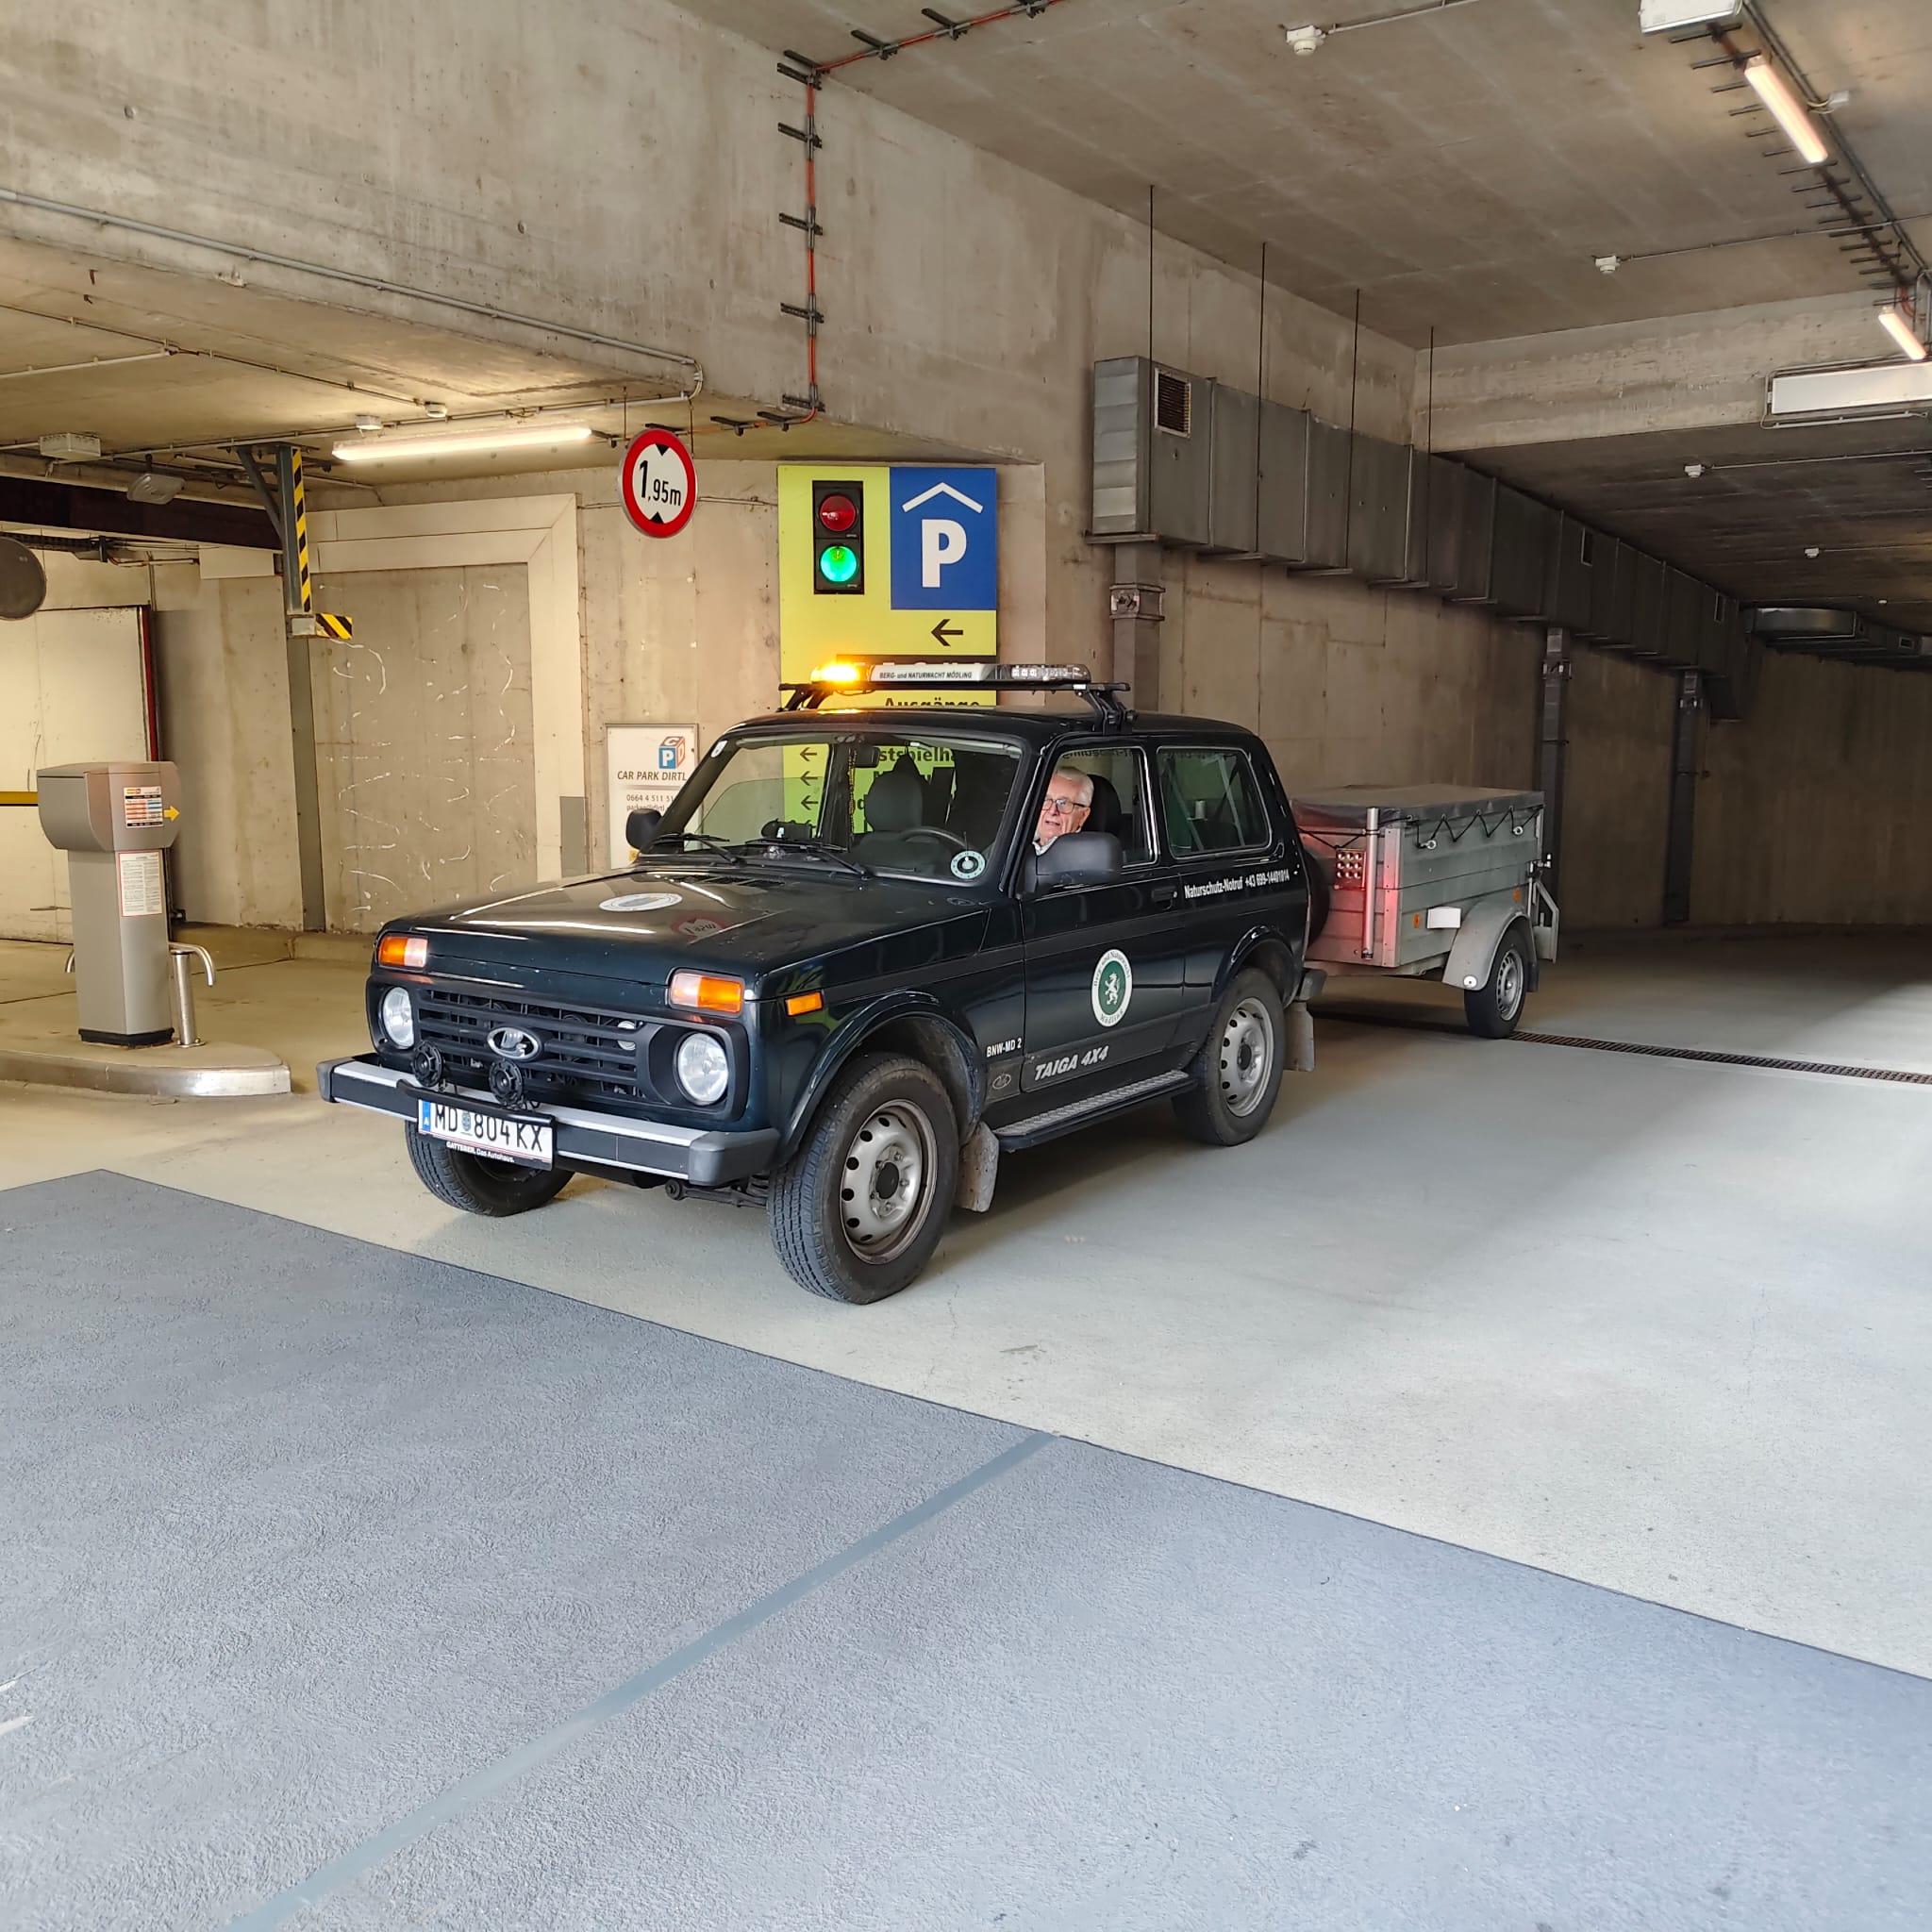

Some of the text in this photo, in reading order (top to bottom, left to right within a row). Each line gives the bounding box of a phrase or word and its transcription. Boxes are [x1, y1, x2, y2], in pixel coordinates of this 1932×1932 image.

[639, 459, 682, 507] 1,95m
[921, 519, 968, 588] P
[946, 671, 973, 679] MÖDLING
[617, 771, 687, 781] CAR PARK DIRTL
[1184, 875, 1243, 899] Naturschutz-Notruf
[986, 1038, 1023, 1058] BNW-MD 2
[1034, 1045, 1109, 1081] TAIGA 4X4
[435, 1104, 458, 1132] MD
